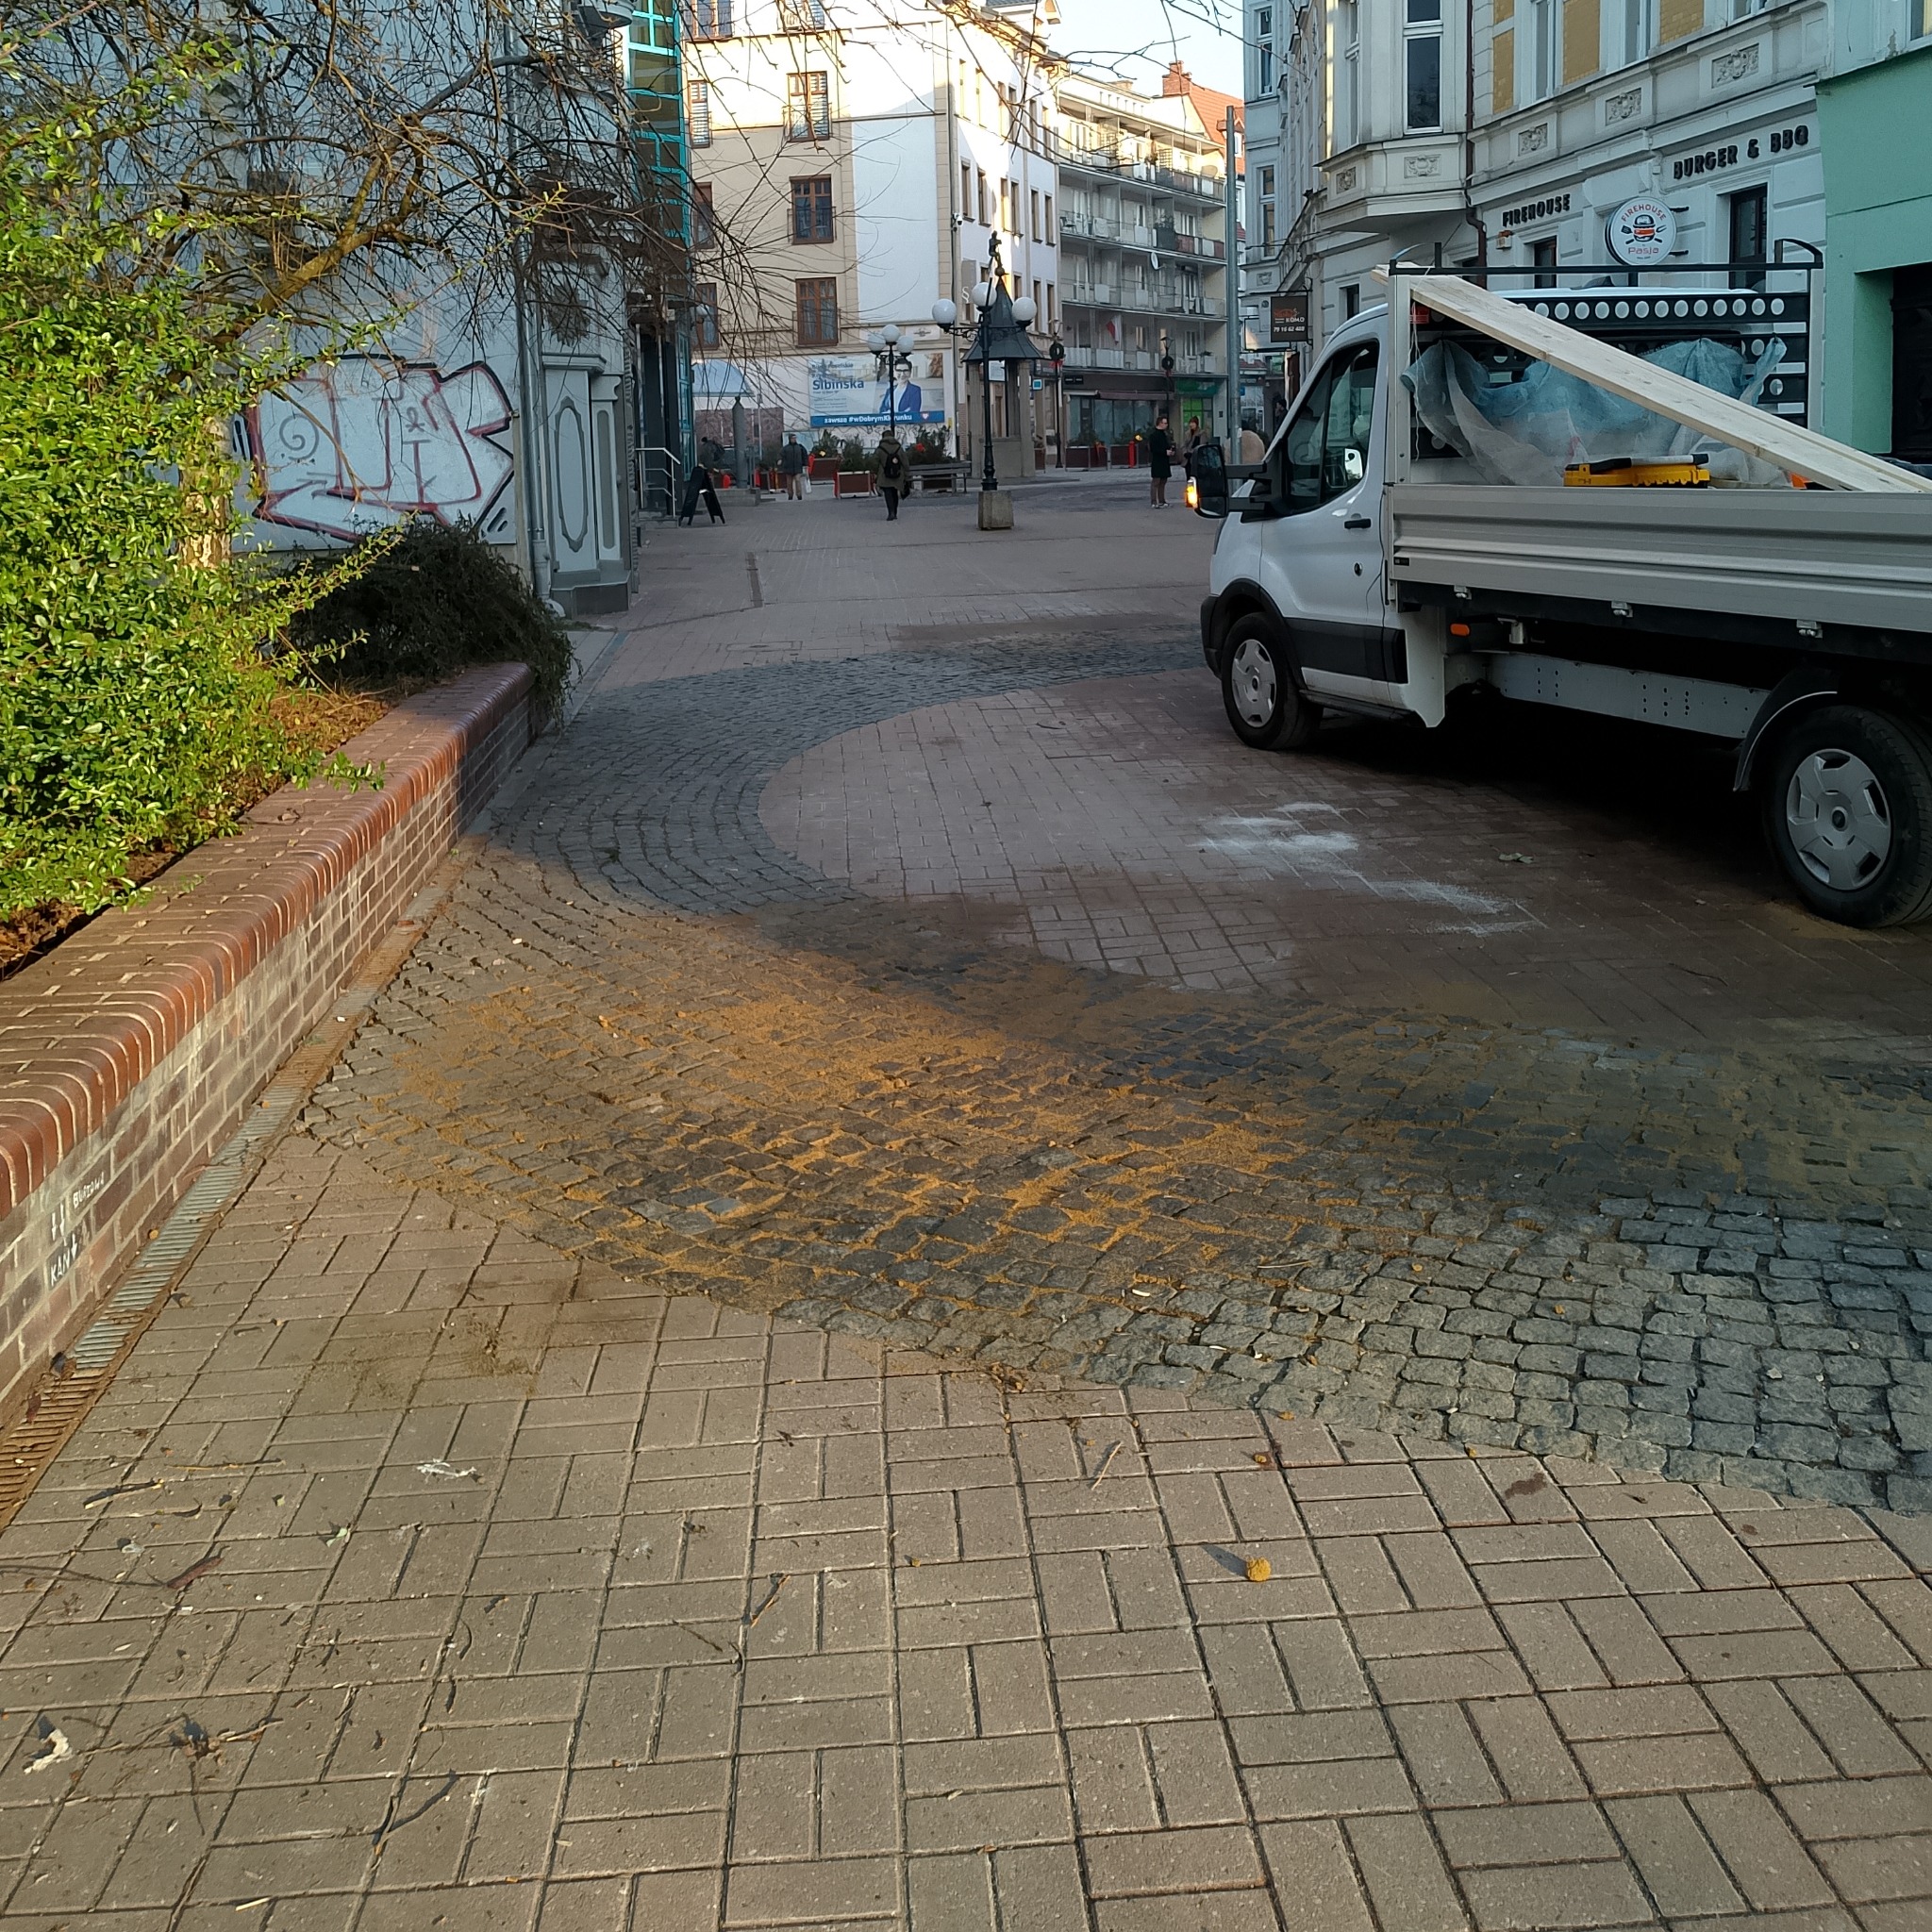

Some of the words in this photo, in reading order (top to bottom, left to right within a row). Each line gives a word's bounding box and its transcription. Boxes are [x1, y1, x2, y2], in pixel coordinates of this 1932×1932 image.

[1674, 145, 1738, 179] BURGER
[1747, 139, 1759, 158] &
[1771, 125, 1808, 153] BBQ
[1503, 193, 1570, 227] FIREHOUSE
[1621, 204, 1667, 222] FIREHOUSE
[1628, 246, 1659, 255] Pasja
